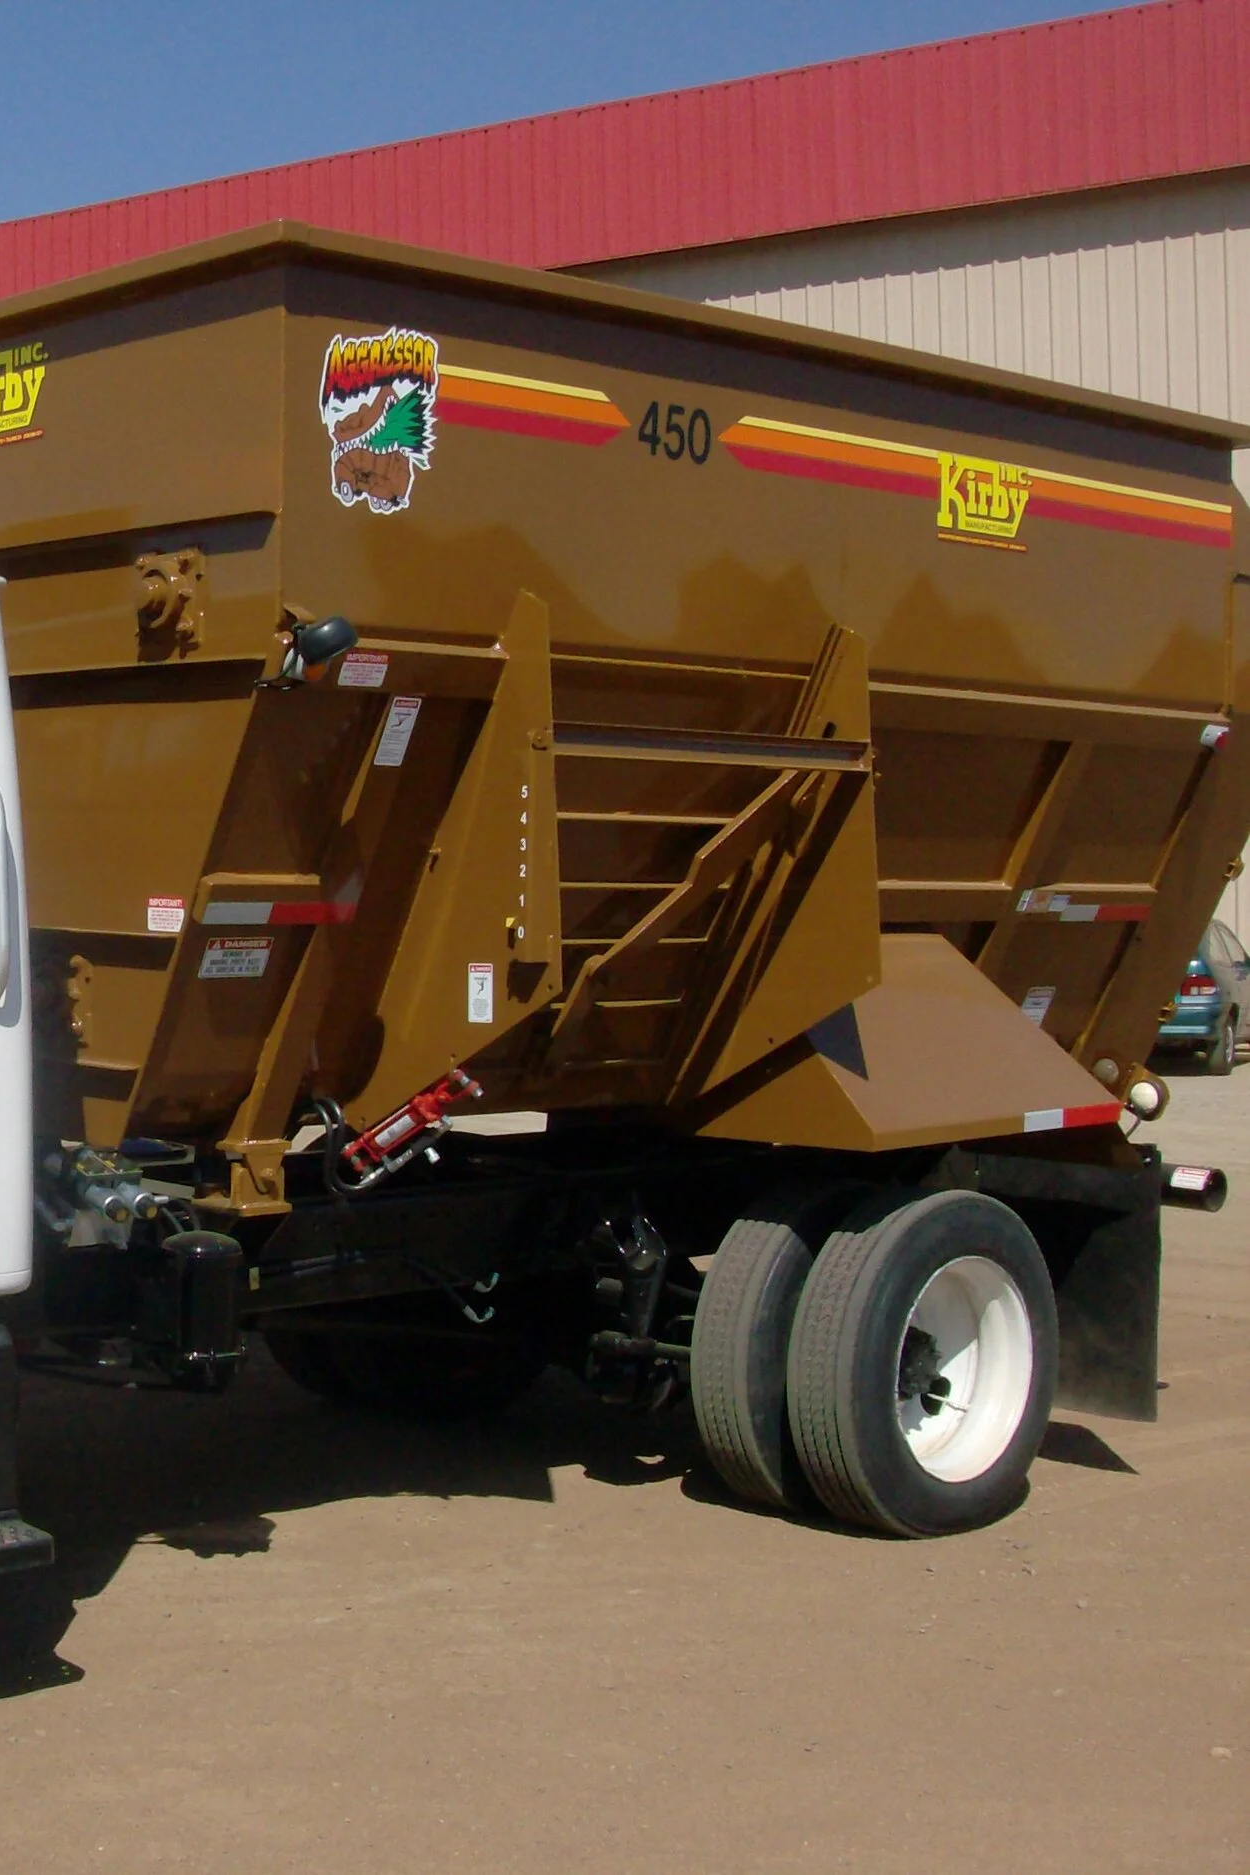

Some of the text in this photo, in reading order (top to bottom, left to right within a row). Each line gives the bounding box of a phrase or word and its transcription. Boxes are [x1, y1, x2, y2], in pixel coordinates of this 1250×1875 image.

[14, 342, 49, 367] INC.
[325, 334, 436, 398] AGGRESSOR
[638, 401, 711, 465] 450
[1000, 461, 1033, 486] INC.
[937, 450, 1029, 538] Kirby
[521, 785, 528, 799] 5
[520, 811, 527, 825] 4
[520, 838, 527, 851] 3
[519, 864, 526, 878] 2
[519, 894, 525, 907] 1
[517, 926, 525, 939] 0
